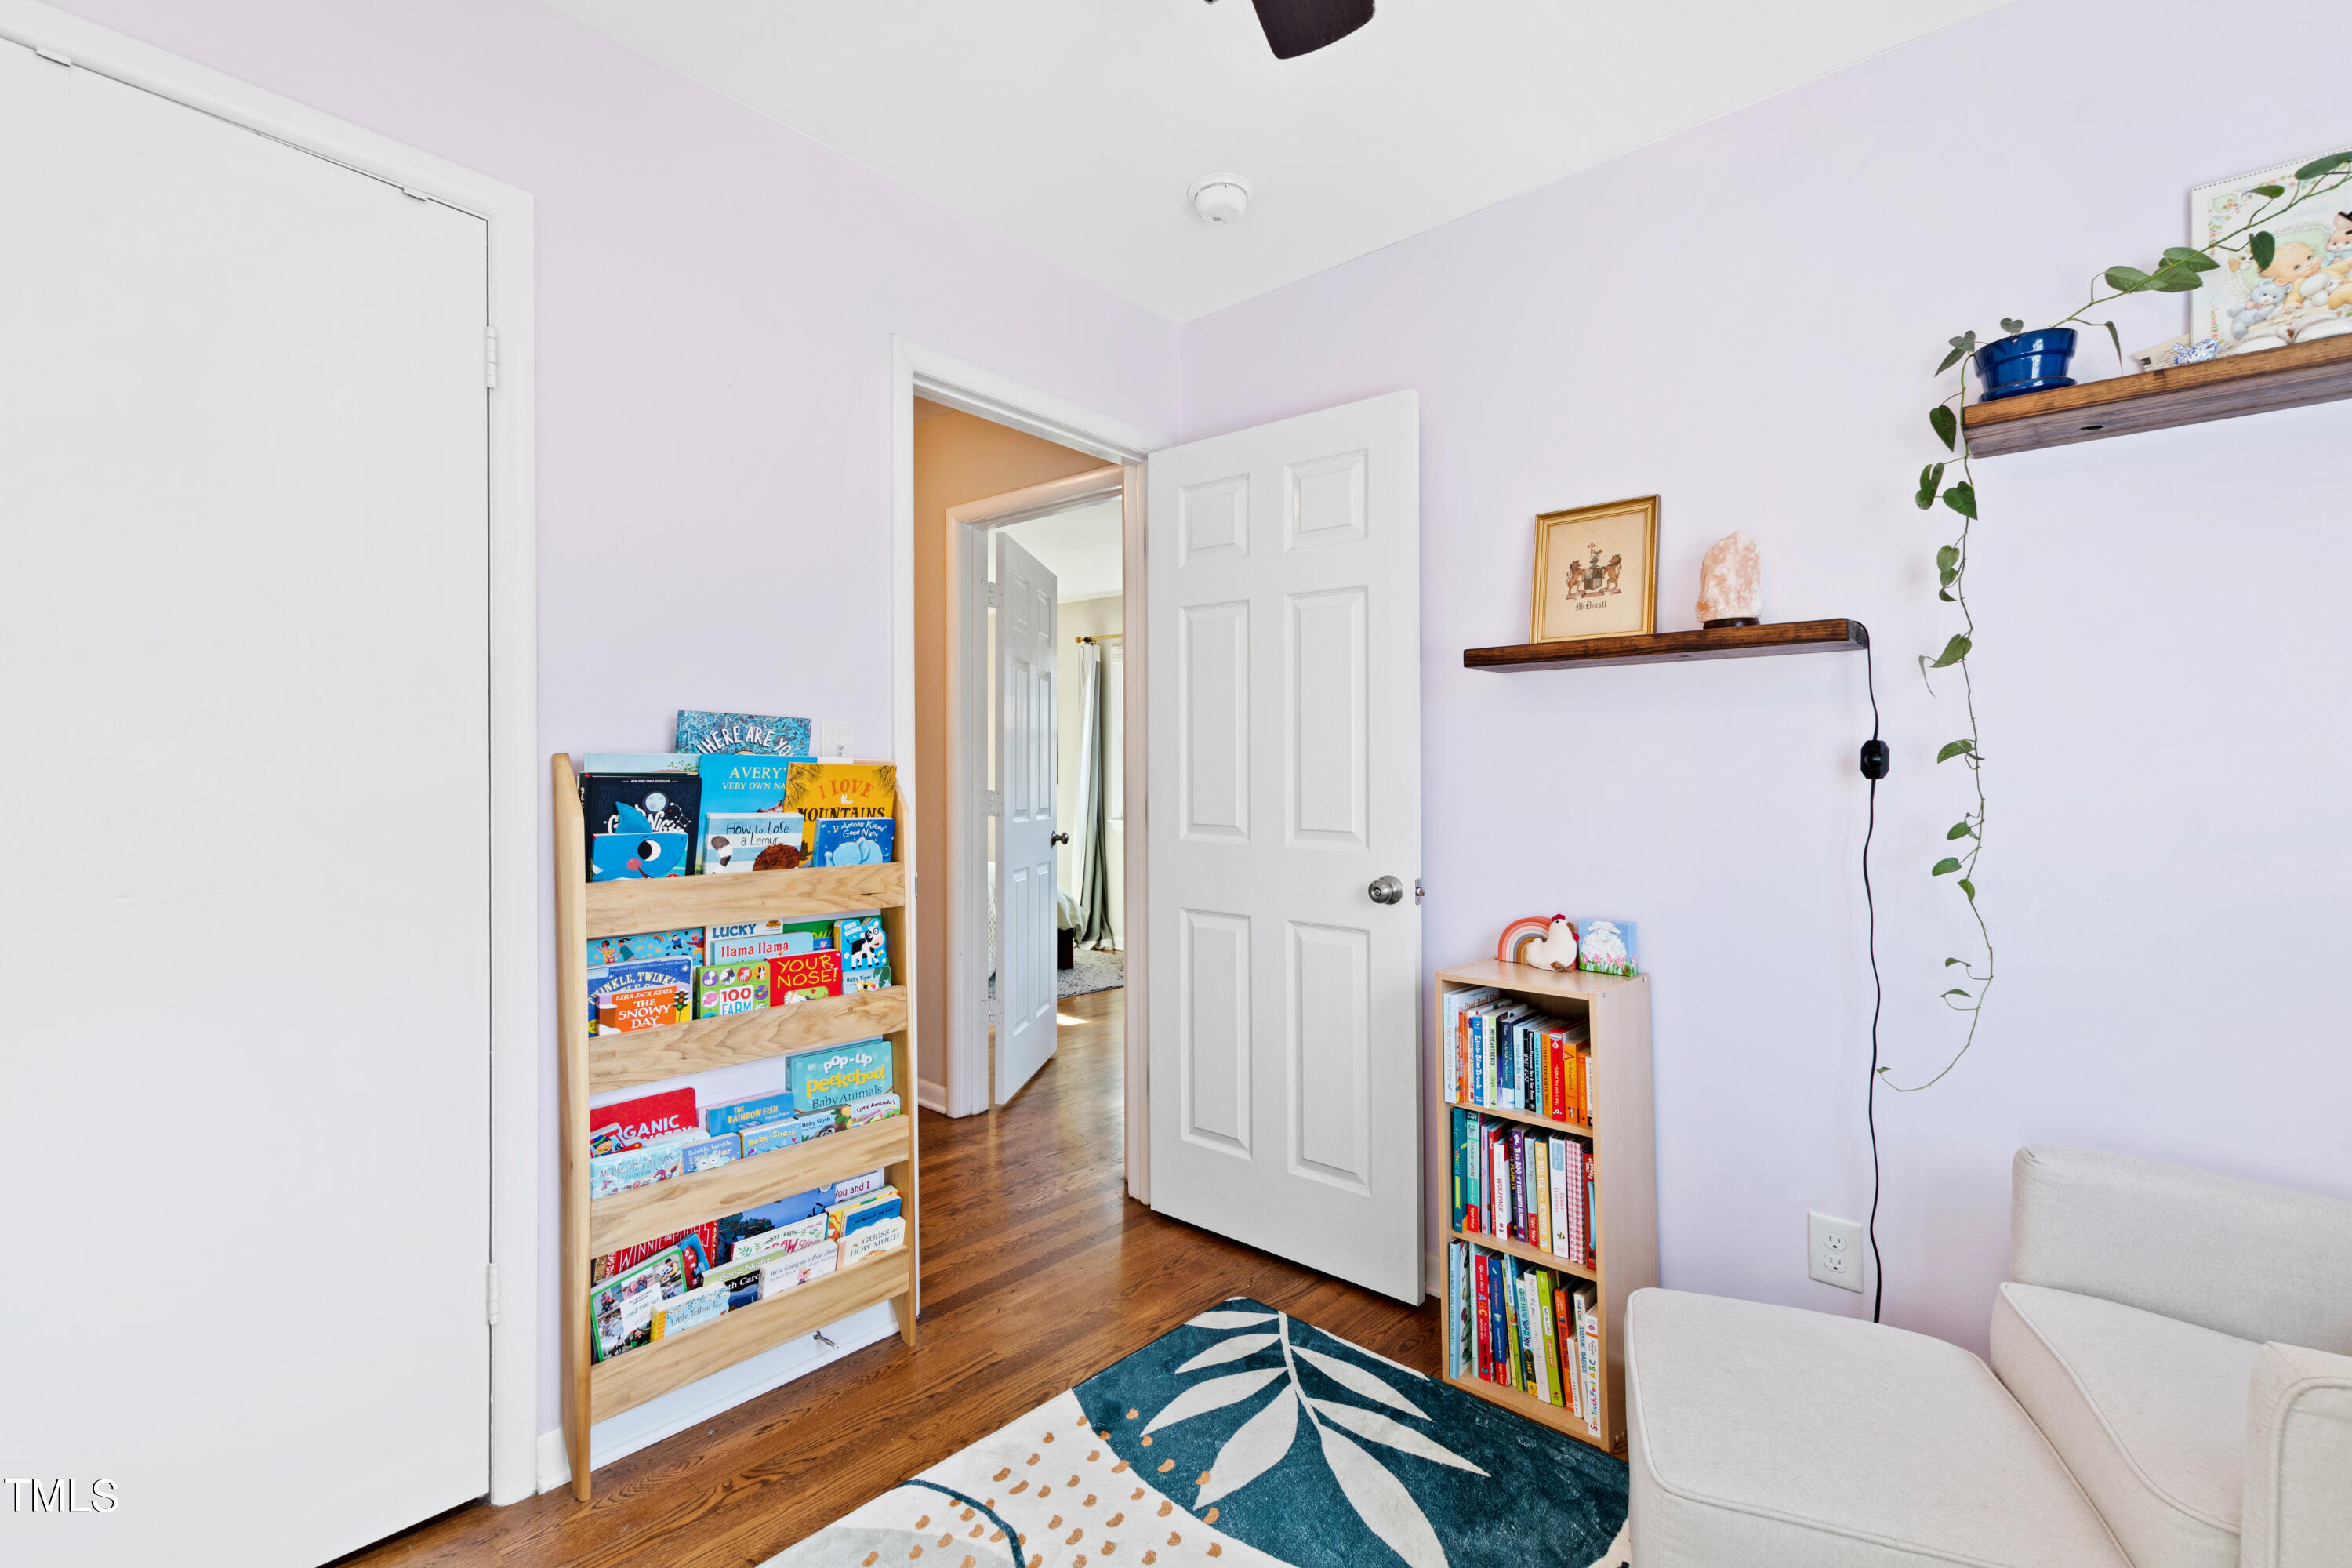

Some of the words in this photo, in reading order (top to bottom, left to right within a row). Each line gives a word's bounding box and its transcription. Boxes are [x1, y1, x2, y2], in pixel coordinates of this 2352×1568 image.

[746, 725, 775, 747] ARE
[773, 737, 795, 757] YO
[722, 782, 746, 790] VERY
[749, 782, 771, 790] OWN
[819, 785, 826, 799] I
[830, 779, 874, 798] LOVE
[840, 793, 853, 804] the
[727, 822, 751, 834] How
[755, 823, 764, 834] to
[768, 821, 789, 833] Lose
[840, 822, 864, 830] Animals
[843, 829, 860, 838] Good
[862, 829, 878, 837] Night
[750, 831, 780, 846] Lemur
[712, 924, 757, 938] LUCKY
[721, 946, 754, 958] llama
[757, 942, 789, 954] llama
[778, 954, 834, 974] YOUR
[777, 967, 838, 989] NOSE!
[587, 973, 636, 1006] TWINKLE,
[653, 988, 673, 996] KEATS
[721, 987, 752, 1003] 100
[633, 998, 656, 1007] THE
[722, 1000, 752, 1016] FARM
[618, 1004, 672, 1021] SNOWY
[631, 1016, 659, 1029] DAY
[1563, 1051, 1575, 1061] A
[806, 1064, 886, 1099] peekaboo!
[812, 1095, 839, 1109] Baby
[840, 1085, 883, 1103] Animals
[856, 1103, 870, 1113] Little
[870, 1098, 896, 1108] Avocado's
[728, 1109, 761, 1123] RAINBOW
[763, 1105, 779, 1116] FISH
[748, 1134, 769, 1147] Baby
[772, 1129, 797, 1139] Shark
[850, 1182, 863, 1195] and
[866, 1181, 870, 1189] I
[1537, 1177, 1546, 1190] YOU
[862, 1229, 890, 1244] GUESS
[850, 1243, 870, 1258] HOW
[873, 1232, 901, 1248] MUCH
[619, 1237, 665, 1274] WINNIE
[720, 1268, 743, 1281] Good
[670, 1313, 688, 1327] Little
[689, 1305, 710, 1318] Yellow
